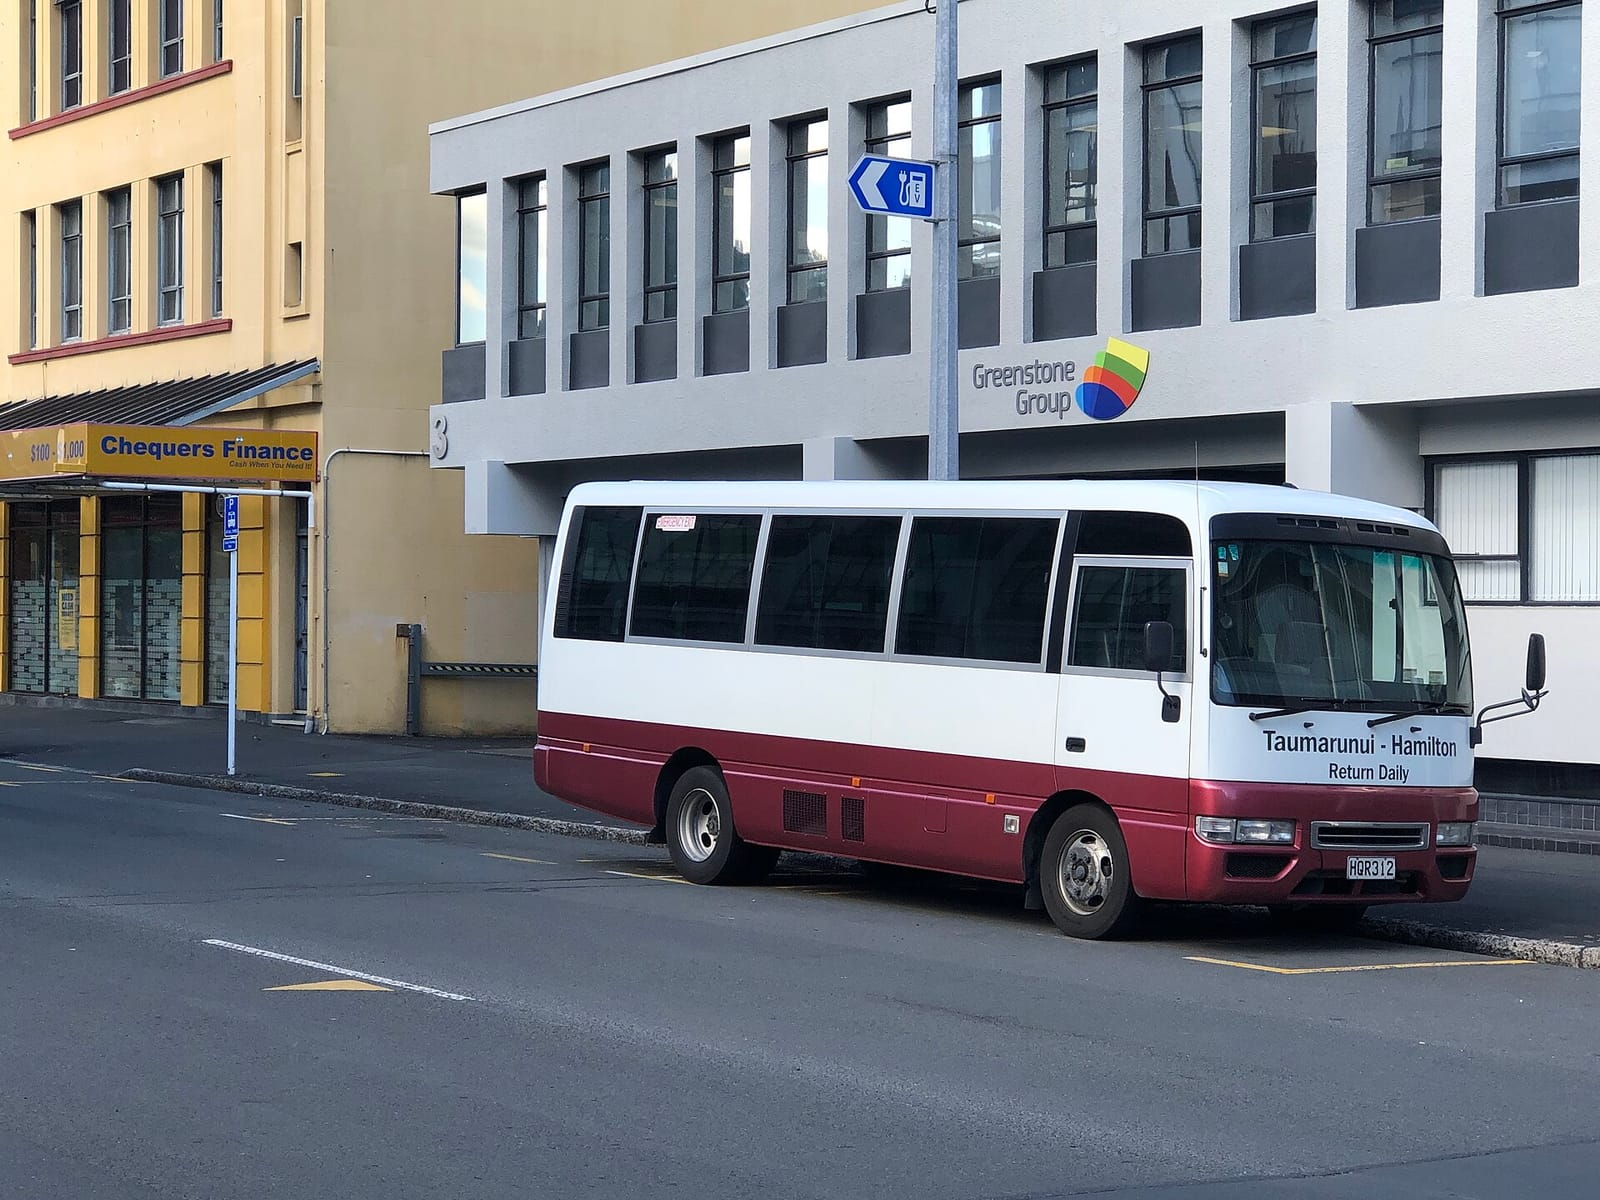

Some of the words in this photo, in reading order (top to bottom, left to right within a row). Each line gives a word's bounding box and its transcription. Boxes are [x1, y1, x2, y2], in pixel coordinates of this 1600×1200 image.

[914, 183, 921, 203] EV
[972, 358, 1075, 389] Greenstone
[1015, 389, 1071, 419] Group
[101, 435, 214, 460] Chequers
[223, 439, 313, 461] Finance
[432, 415, 448, 460] 3
[31, 444, 50, 463] $100
[229, 460, 247, 468] Cash
[272, 461, 284, 469] You
[285, 462, 304, 470] Need
[229, 498, 234, 510] P
[1263, 730, 1375, 754] Taumarunui
[1392, 735, 1457, 757] Hamilton
[1329, 763, 1374, 780] Return
[1379, 765, 1410, 784] Daily
[1349, 860, 1394, 876] HQR312
